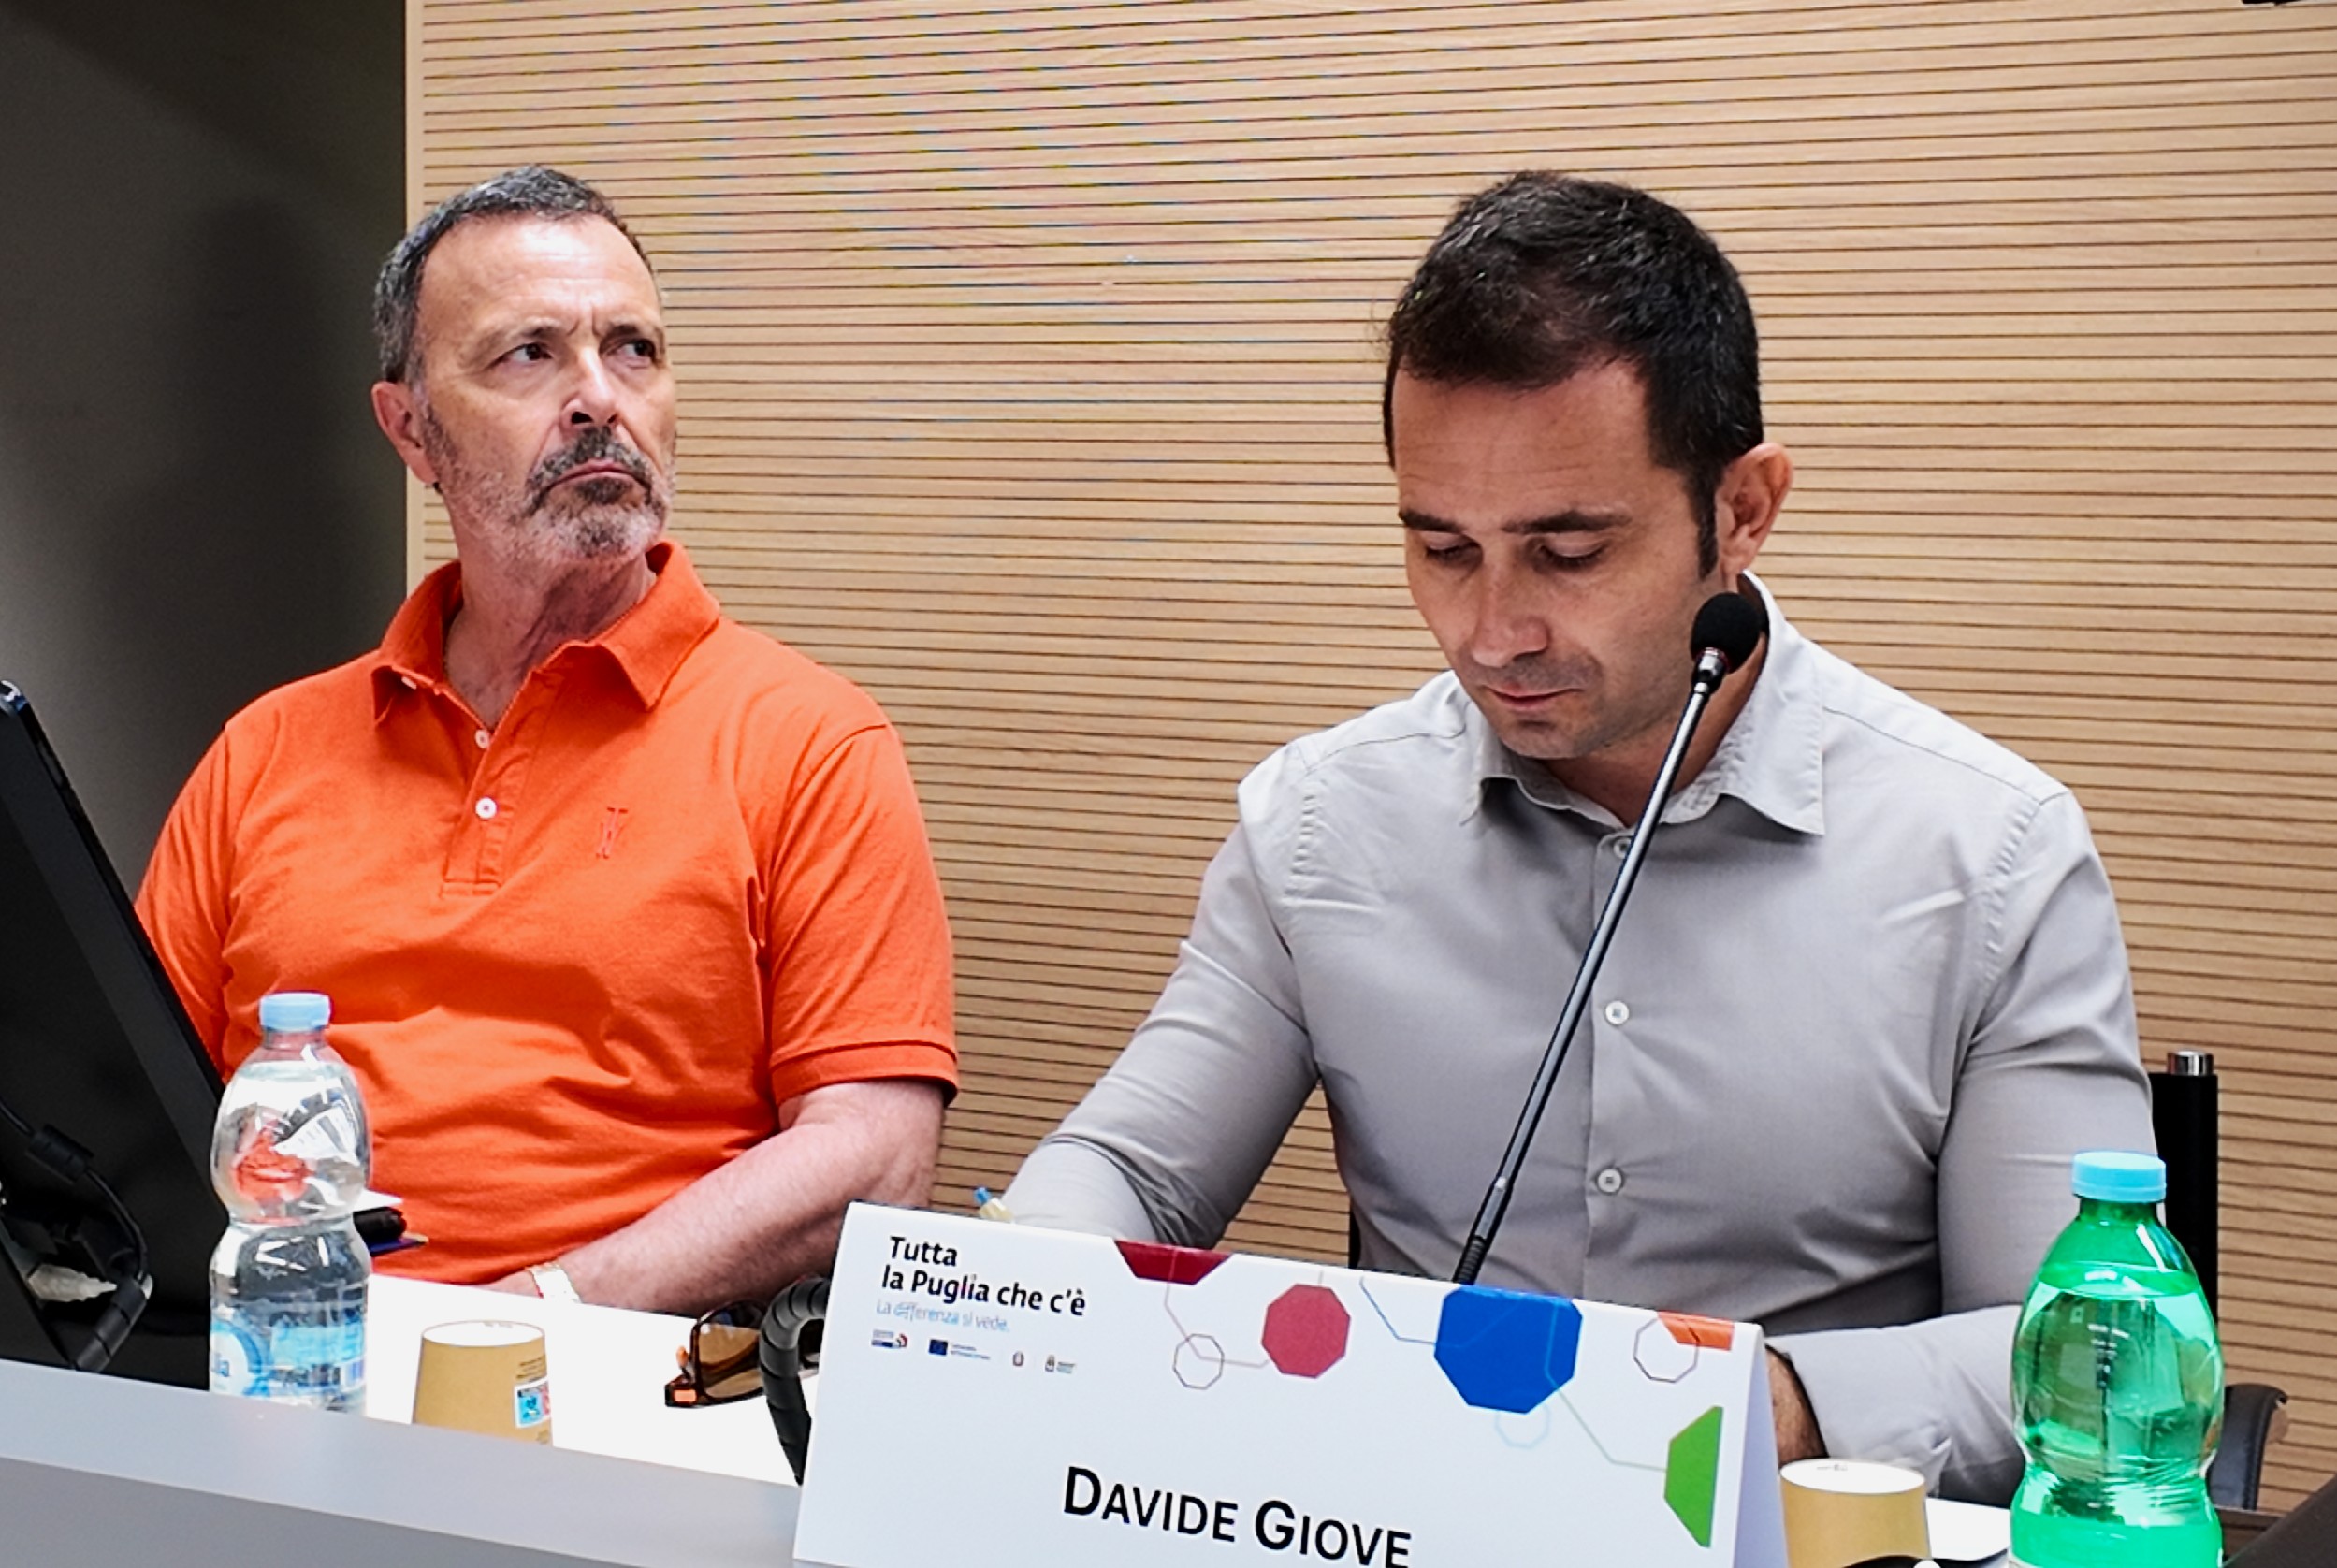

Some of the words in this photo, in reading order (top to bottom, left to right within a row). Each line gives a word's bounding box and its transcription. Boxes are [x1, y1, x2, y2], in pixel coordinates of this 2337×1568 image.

[890, 1235, 958, 1267] Tutta
[881, 1264, 904, 1290] la
[910, 1270, 990, 1304] Puglia
[997, 1282, 1043, 1310] che
[1049, 1288, 1086, 1316] c'è
[876, 1300, 891, 1314] La
